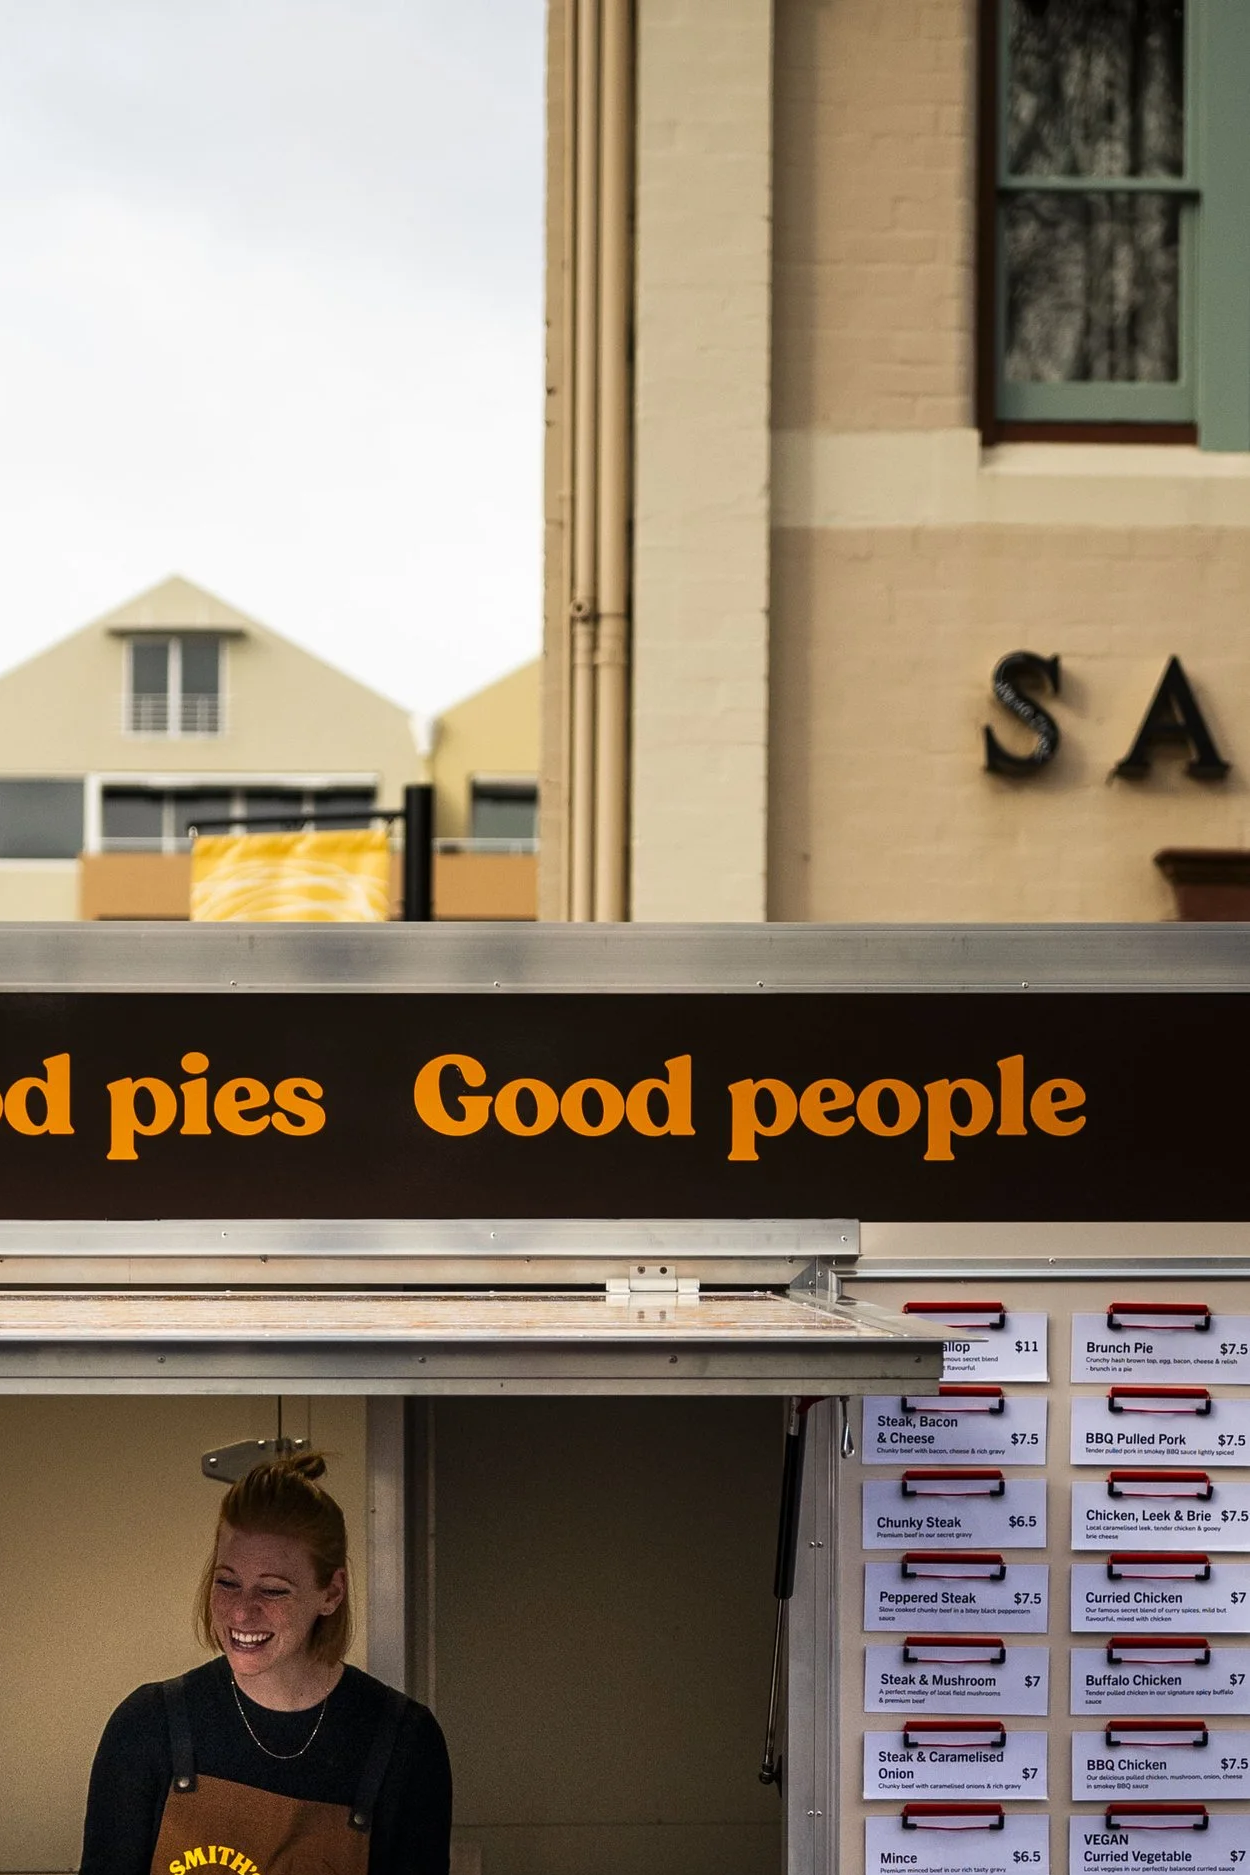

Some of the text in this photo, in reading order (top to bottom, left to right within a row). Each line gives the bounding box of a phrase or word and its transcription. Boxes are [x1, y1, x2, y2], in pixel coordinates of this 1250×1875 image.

[107, 1052, 326, 1160] pies
[414, 1054, 1085, 1160] Good people
[943, 1342, 970, 1354] allop
[1016, 1341, 1038, 1353] $11
[1087, 1342, 1153, 1353] Brunch Pie
[1220, 1343, 1248, 1355] $7.5
[878, 1415, 957, 1428] Steak, Bacon
[877, 1432, 934, 1444] & Cheese
[1011, 1433, 1038, 1445] $7.5
[1086, 1433, 1186, 1445] BBQ Pulled Pork
[1218, 1434, 1245, 1446] $7.5
[1009, 1516, 1036, 1528] $6.5
[1087, 1510, 1211, 1522] Chicken, Leek & Brie
[1221, 1510, 1248, 1522] $7.5
[877, 1517, 961, 1530] Chunky Steak
[880, 1592, 976, 1605] Peppered Steak
[1014, 1592, 1041, 1605] $7.5
[1086, 1592, 1182, 1603] Curried Chicken
[1231, 1592, 1246, 1604] $7
[881, 1674, 996, 1686] Steak & Mushroom
[1025, 1675, 1040, 1687] $7
[1086, 1675, 1181, 1686] Buffalo Chicken
[1230, 1674, 1245, 1686] $7
[879, 1751, 1003, 1762] Steak & Caramelised
[1088, 1759, 1166, 1771] BBQ Chicken
[1221, 1758, 1248, 1770] $7.5
[879, 1768, 913, 1779] Onion
[1023, 1768, 1038, 1780] $7
[1084, 1834, 1128, 1845] VEGAN
[881, 1853, 917, 1863] Mince
[1013, 1851, 1040, 1863] $6.5
[1084, 1851, 1192, 1864] Curried Vegetable
[1231, 1850, 1246, 1862] $7
